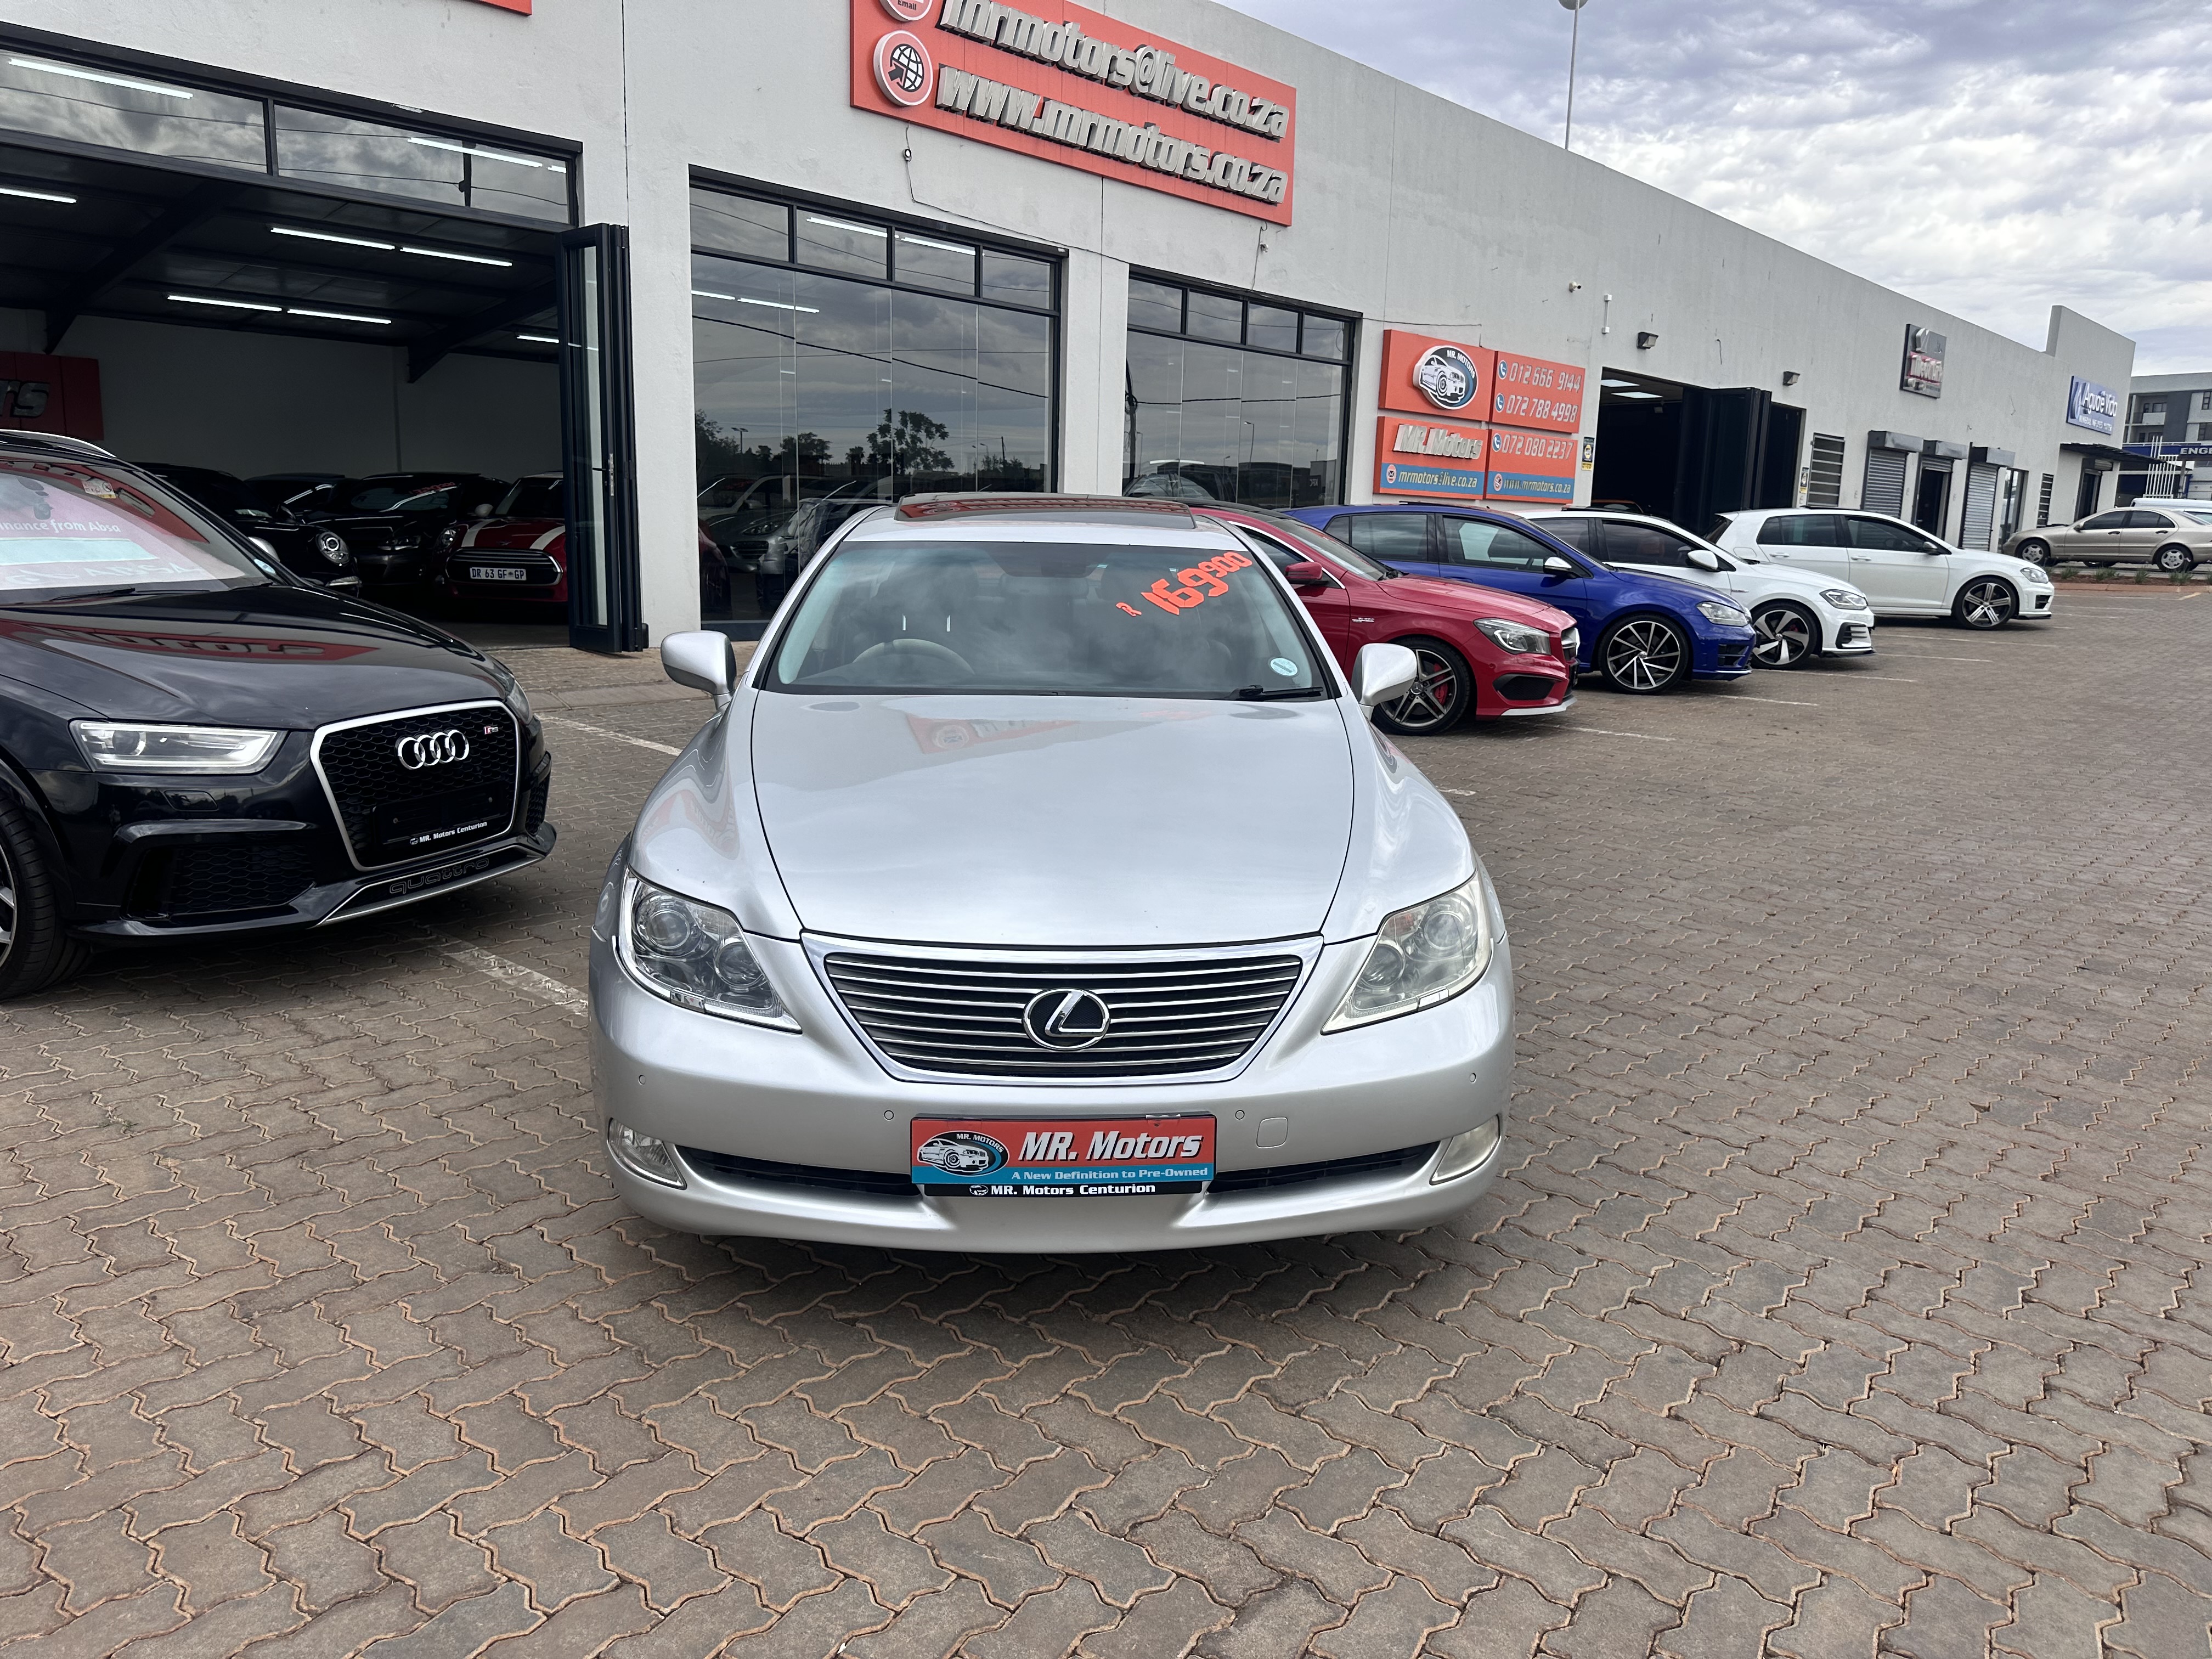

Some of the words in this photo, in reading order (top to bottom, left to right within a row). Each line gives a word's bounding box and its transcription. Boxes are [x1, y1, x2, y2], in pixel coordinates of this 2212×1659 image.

[898, 0, 917, 10] Email
[940, 0, 1290, 140] mrmotors@live.co.za
[935, 65, 1288, 204] www.mrmotors.co.za
[1447, 349, 1457, 359] MR.
[1457, 352, 1476, 379] MOTORS
[1509, 362, 1532, 385] 012
[1533, 367, 1554, 389] 666
[1557, 371, 1582, 393] 9144
[1506, 394, 1528, 417] 072
[1531, 397, 1550, 420] 788
[1551, 402, 1578, 424] 4998
[1393, 424, 1426, 454] MR.
[1426, 428, 1483, 460] Motors
[1502, 433, 1523, 455] 072
[1524, 436, 1545, 458] 080
[1546, 439, 1574, 460] 2237
[0, 520, 48, 531] inance
[49, 518, 87, 533] from
[89, 521, 121, 532] Absa
[84, 562, 204, 577] ABSA
[472, 568, 481, 578] DR
[485, 569, 494, 578] 63
[498, 569, 507, 579] GF
[515, 570, 524, 579] GP
[433, 829, 455, 839] Motors
[457, 822, 487, 833] Centurion
[390, 857, 489, 894] quattro
[973, 1135, 1005, 1153] MOTORS
[1018, 1132, 1079, 1161] MR.
[1088, 1131, 1203, 1161] Motors
[1023, 1171, 1052, 1180] New
[1055, 1169, 1119, 1180] Definition
[1122, 1169, 1136, 1178] to
[1138, 1167, 1209, 1178] Pre-Owned
[991, 1185, 1018, 1195] MR.
[1023, 1184, 1074, 1195] Motors
[1080, 1183, 1155, 1195] Centurion
